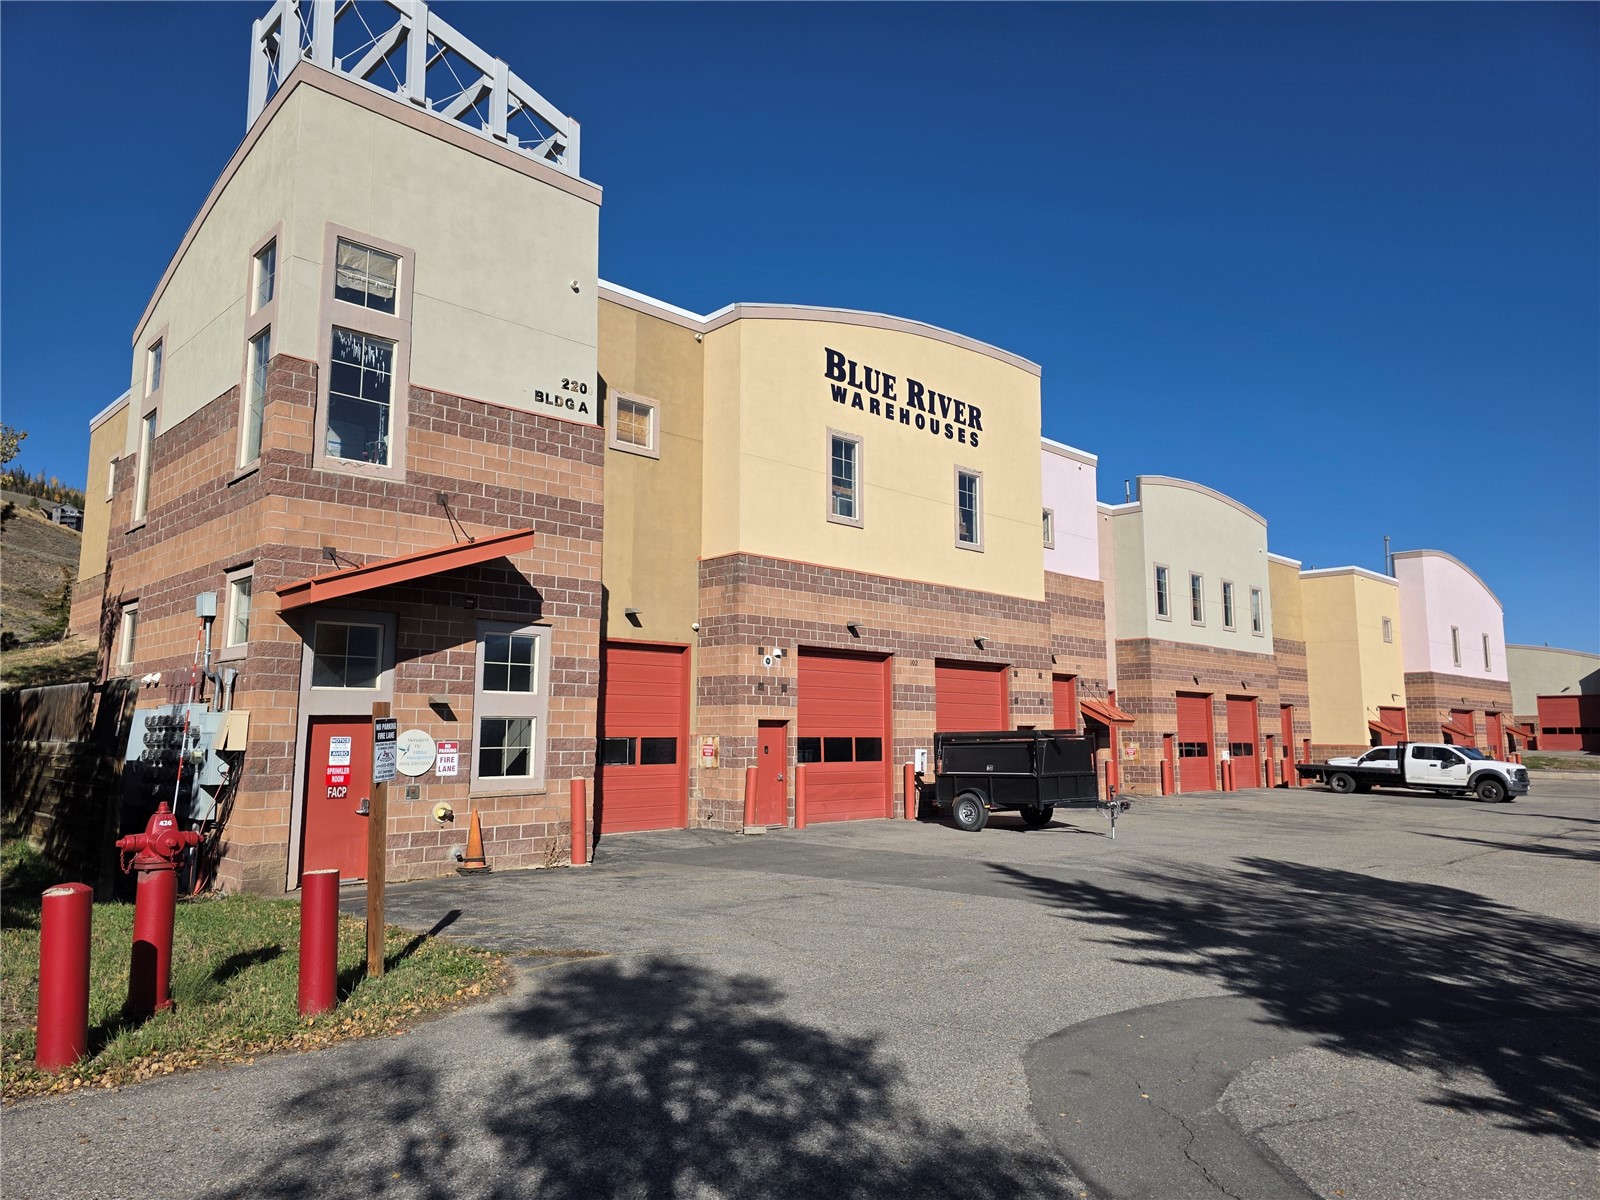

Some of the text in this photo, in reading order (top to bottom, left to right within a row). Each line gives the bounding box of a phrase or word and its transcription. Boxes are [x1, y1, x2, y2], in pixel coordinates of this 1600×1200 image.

[561, 378, 587, 394] 220
[824, 347, 983, 431] BLUE RIVER
[534, 390, 588, 414] BLDG A
[830, 383, 979, 448] WAREHOUSES
[376, 722, 396, 731] NO PARKING
[377, 731, 395, 740] FIRE LANE
[326, 767, 350, 775] SPRINKLER
[331, 775, 344, 783] ROOM
[327, 786, 347, 798] FACP
